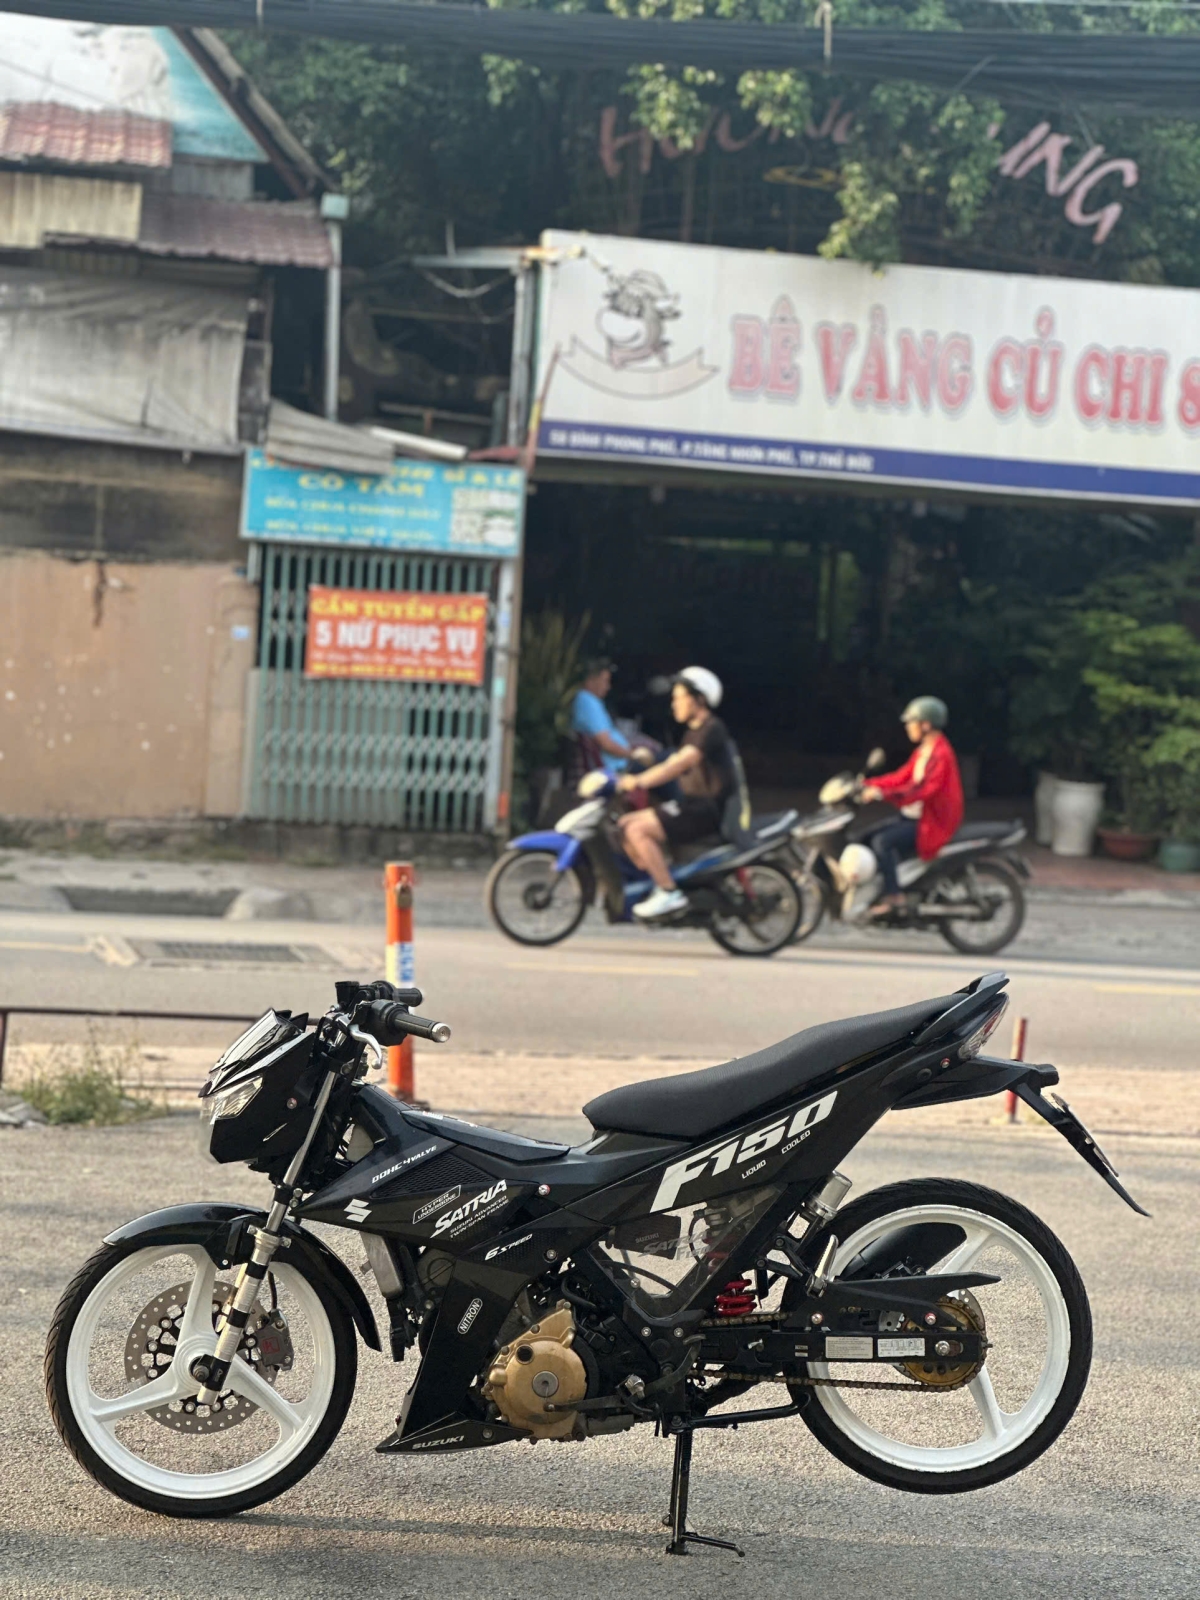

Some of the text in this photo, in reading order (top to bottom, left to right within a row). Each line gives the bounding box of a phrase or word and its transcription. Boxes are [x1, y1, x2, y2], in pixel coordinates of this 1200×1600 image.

[729, 295, 802, 403] BÊ
[988, 307, 1063, 418] CỦ
[1075, 345, 1168, 425] CHI
[315, 620, 332, 647] 5
[377, 622, 440, 656] PHỤC
[445, 627, 477, 660] VỤ
[650, 1090, 838, 1213] F150
[741, 1129, 811, 1180] LIQUID COOLED
[371, 1161, 403, 1184] DOHC
[417, 1193, 456, 1220] UNDERBONE
[421, 1193, 450, 1213] HYPER
[430, 1179, 507, 1239] SATRIA
[450, 1195, 508, 1234] SUZUKI ADVANCED
[487, 1199, 510, 1216] FRAME
[635, 1232, 660, 1244] SUZUKI
[459, 1300, 482, 1333] NITRON
[412, 1435, 465, 1450] SUZUKI
